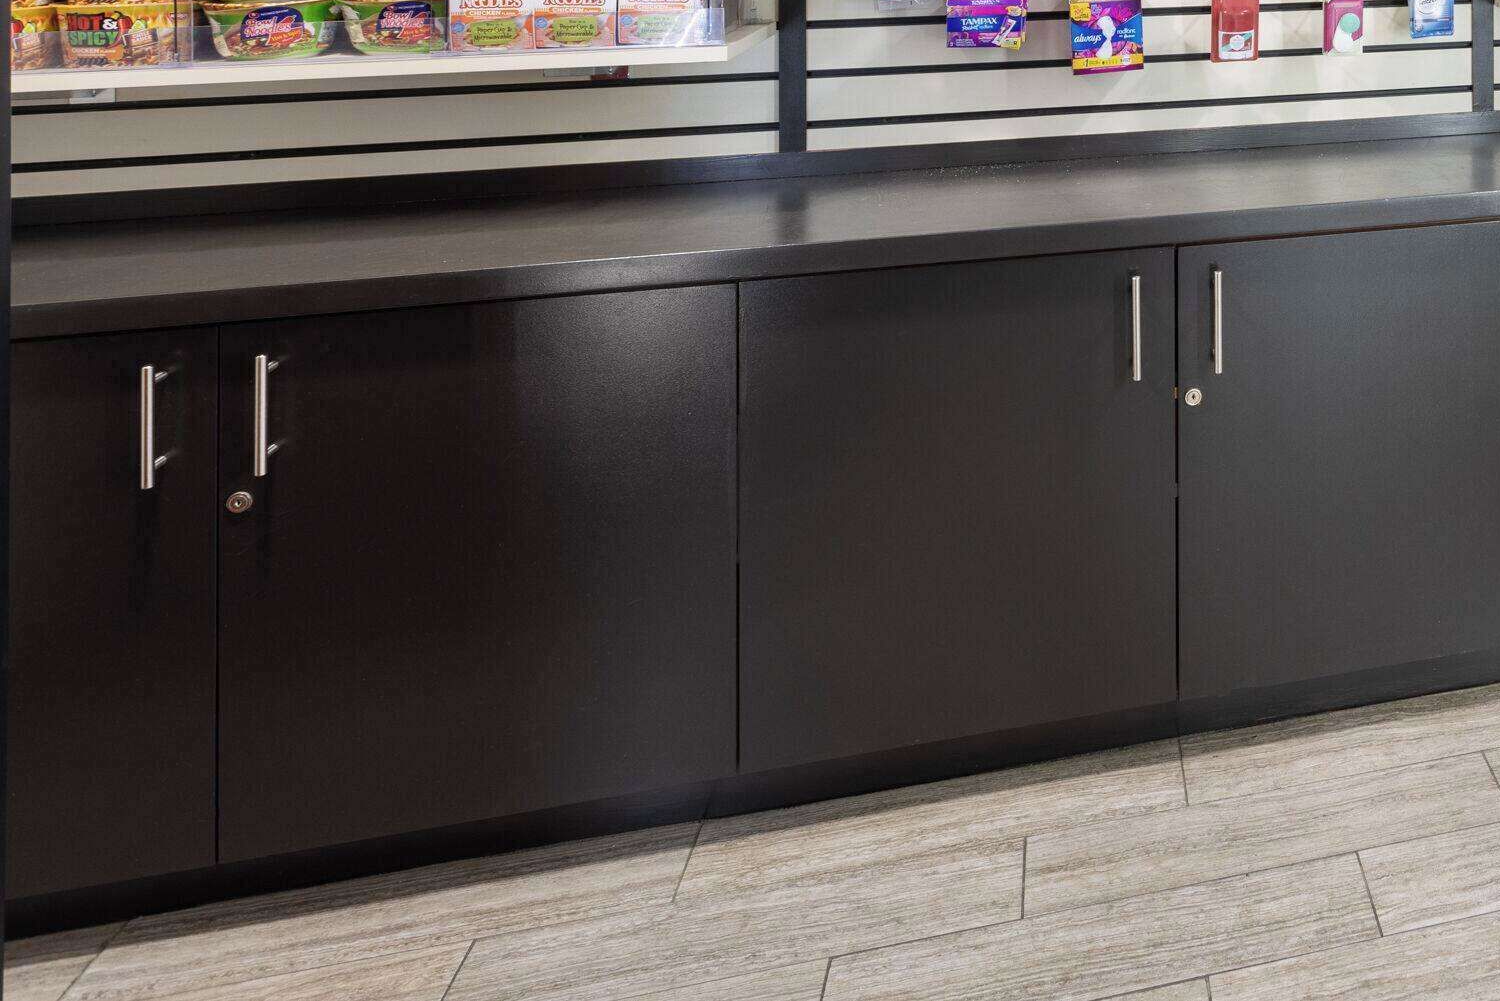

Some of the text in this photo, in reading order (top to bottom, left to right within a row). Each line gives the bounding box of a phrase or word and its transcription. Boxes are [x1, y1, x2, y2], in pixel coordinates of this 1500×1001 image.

[67, 13, 118, 31] HOT &
[960, 17, 998, 26] TAMPAX
[68, 30, 119, 47] SPICY
[1074, 33, 1102, 44] always
